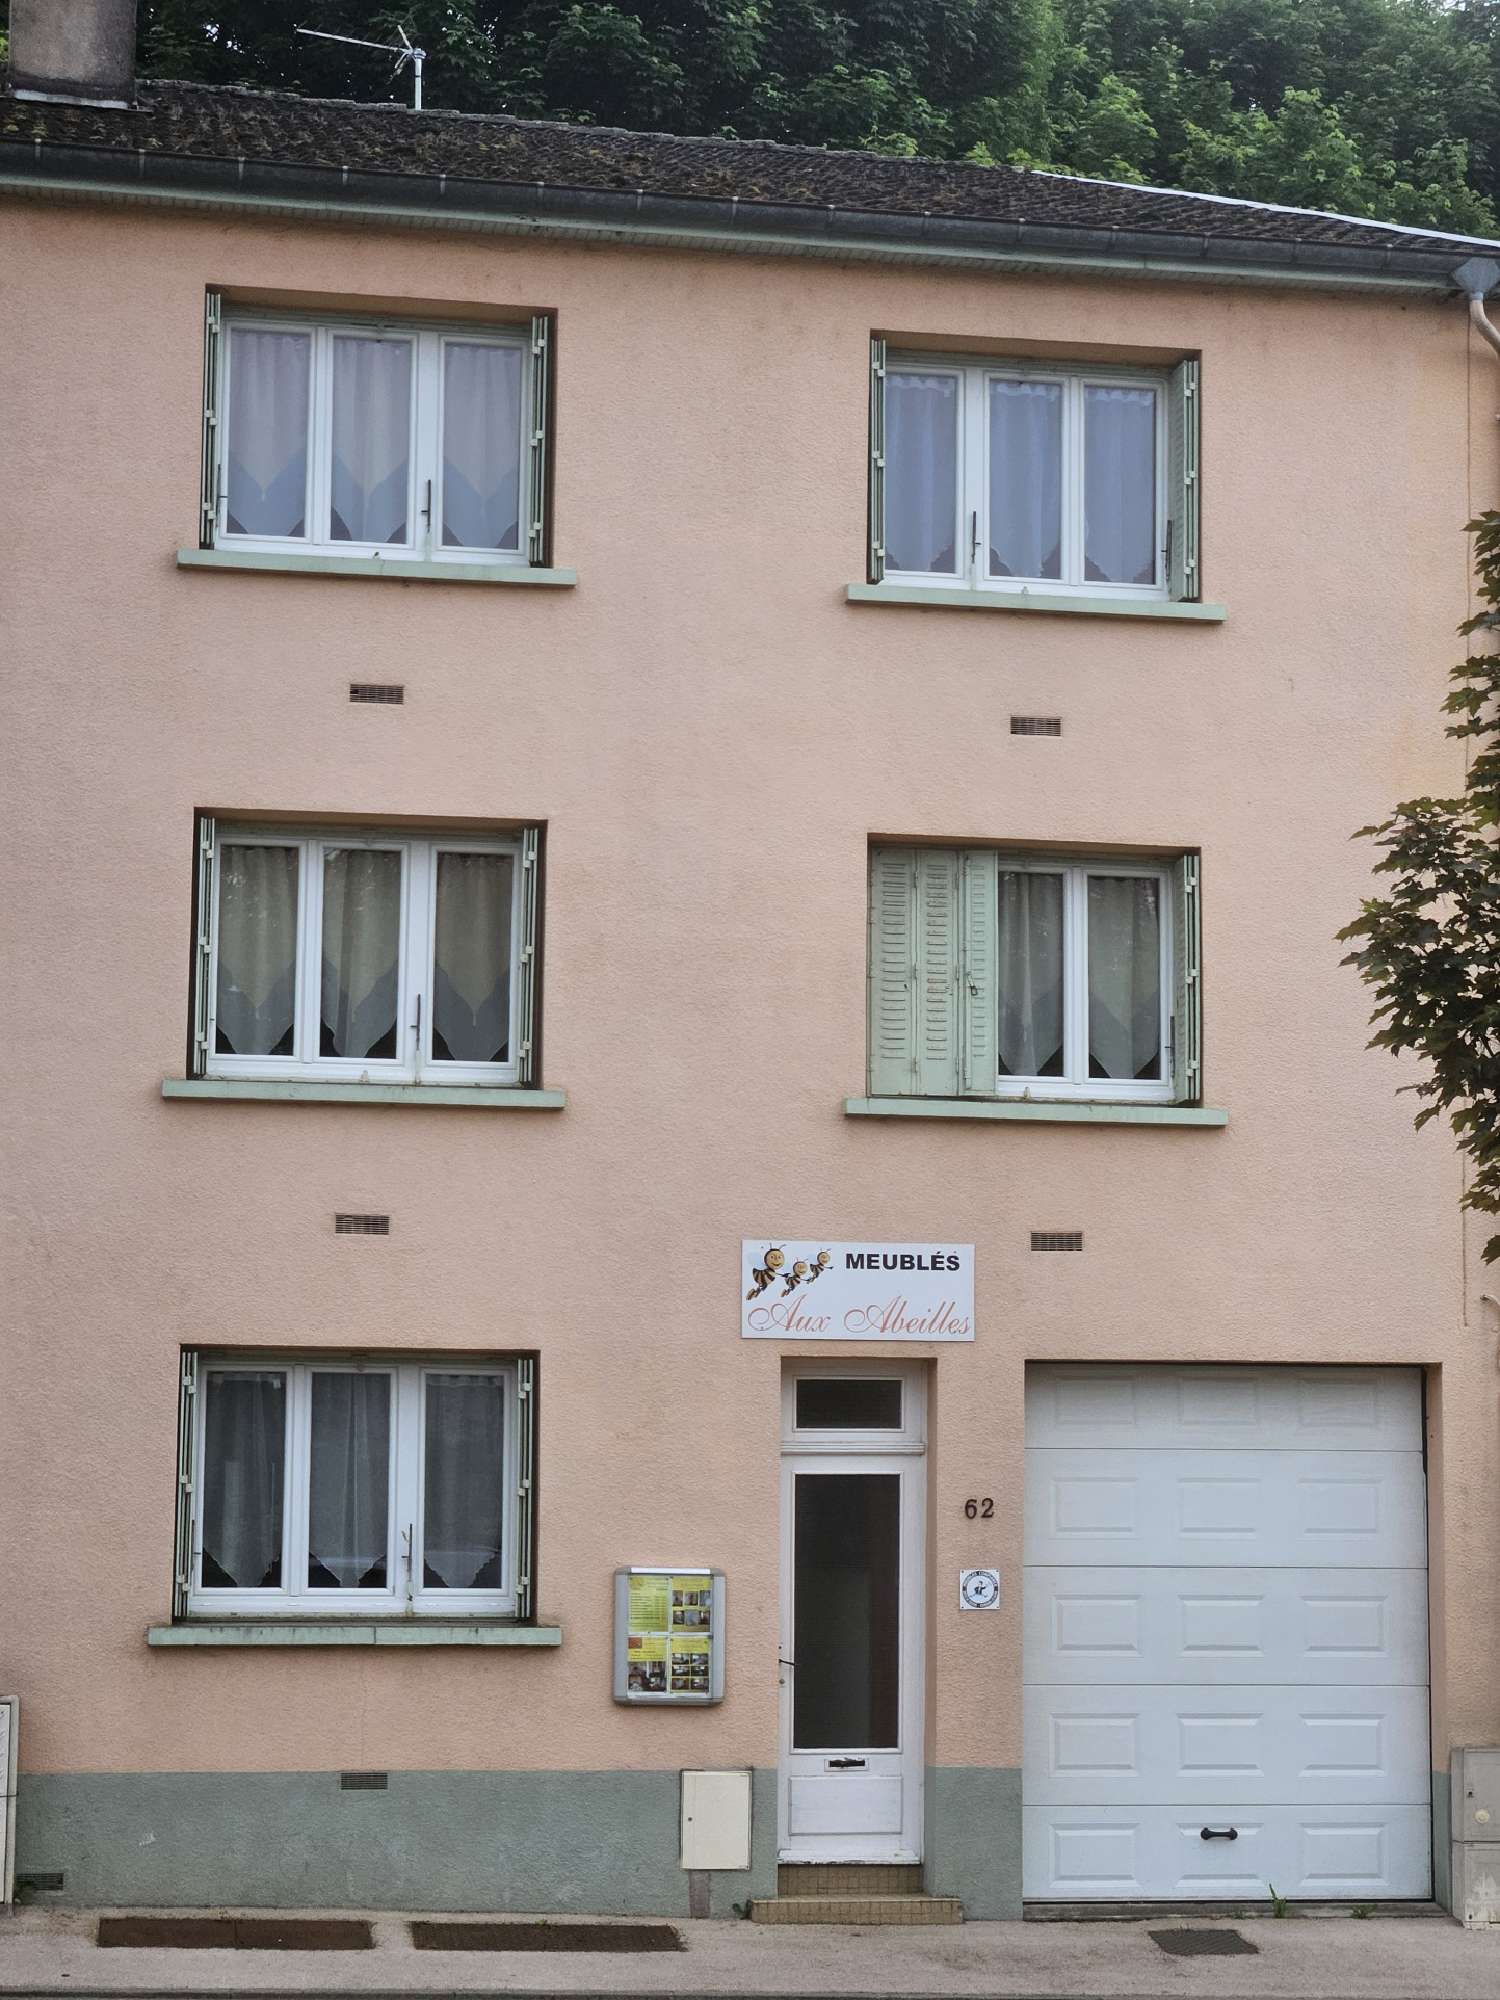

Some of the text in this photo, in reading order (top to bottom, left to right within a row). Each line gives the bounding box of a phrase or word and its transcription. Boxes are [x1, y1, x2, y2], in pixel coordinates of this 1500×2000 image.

[845, 1251, 960, 1272] MEUBLÉS
[747, 1294, 971, 1335] Aux Abeilles
[964, 1498, 995, 1520] 62
